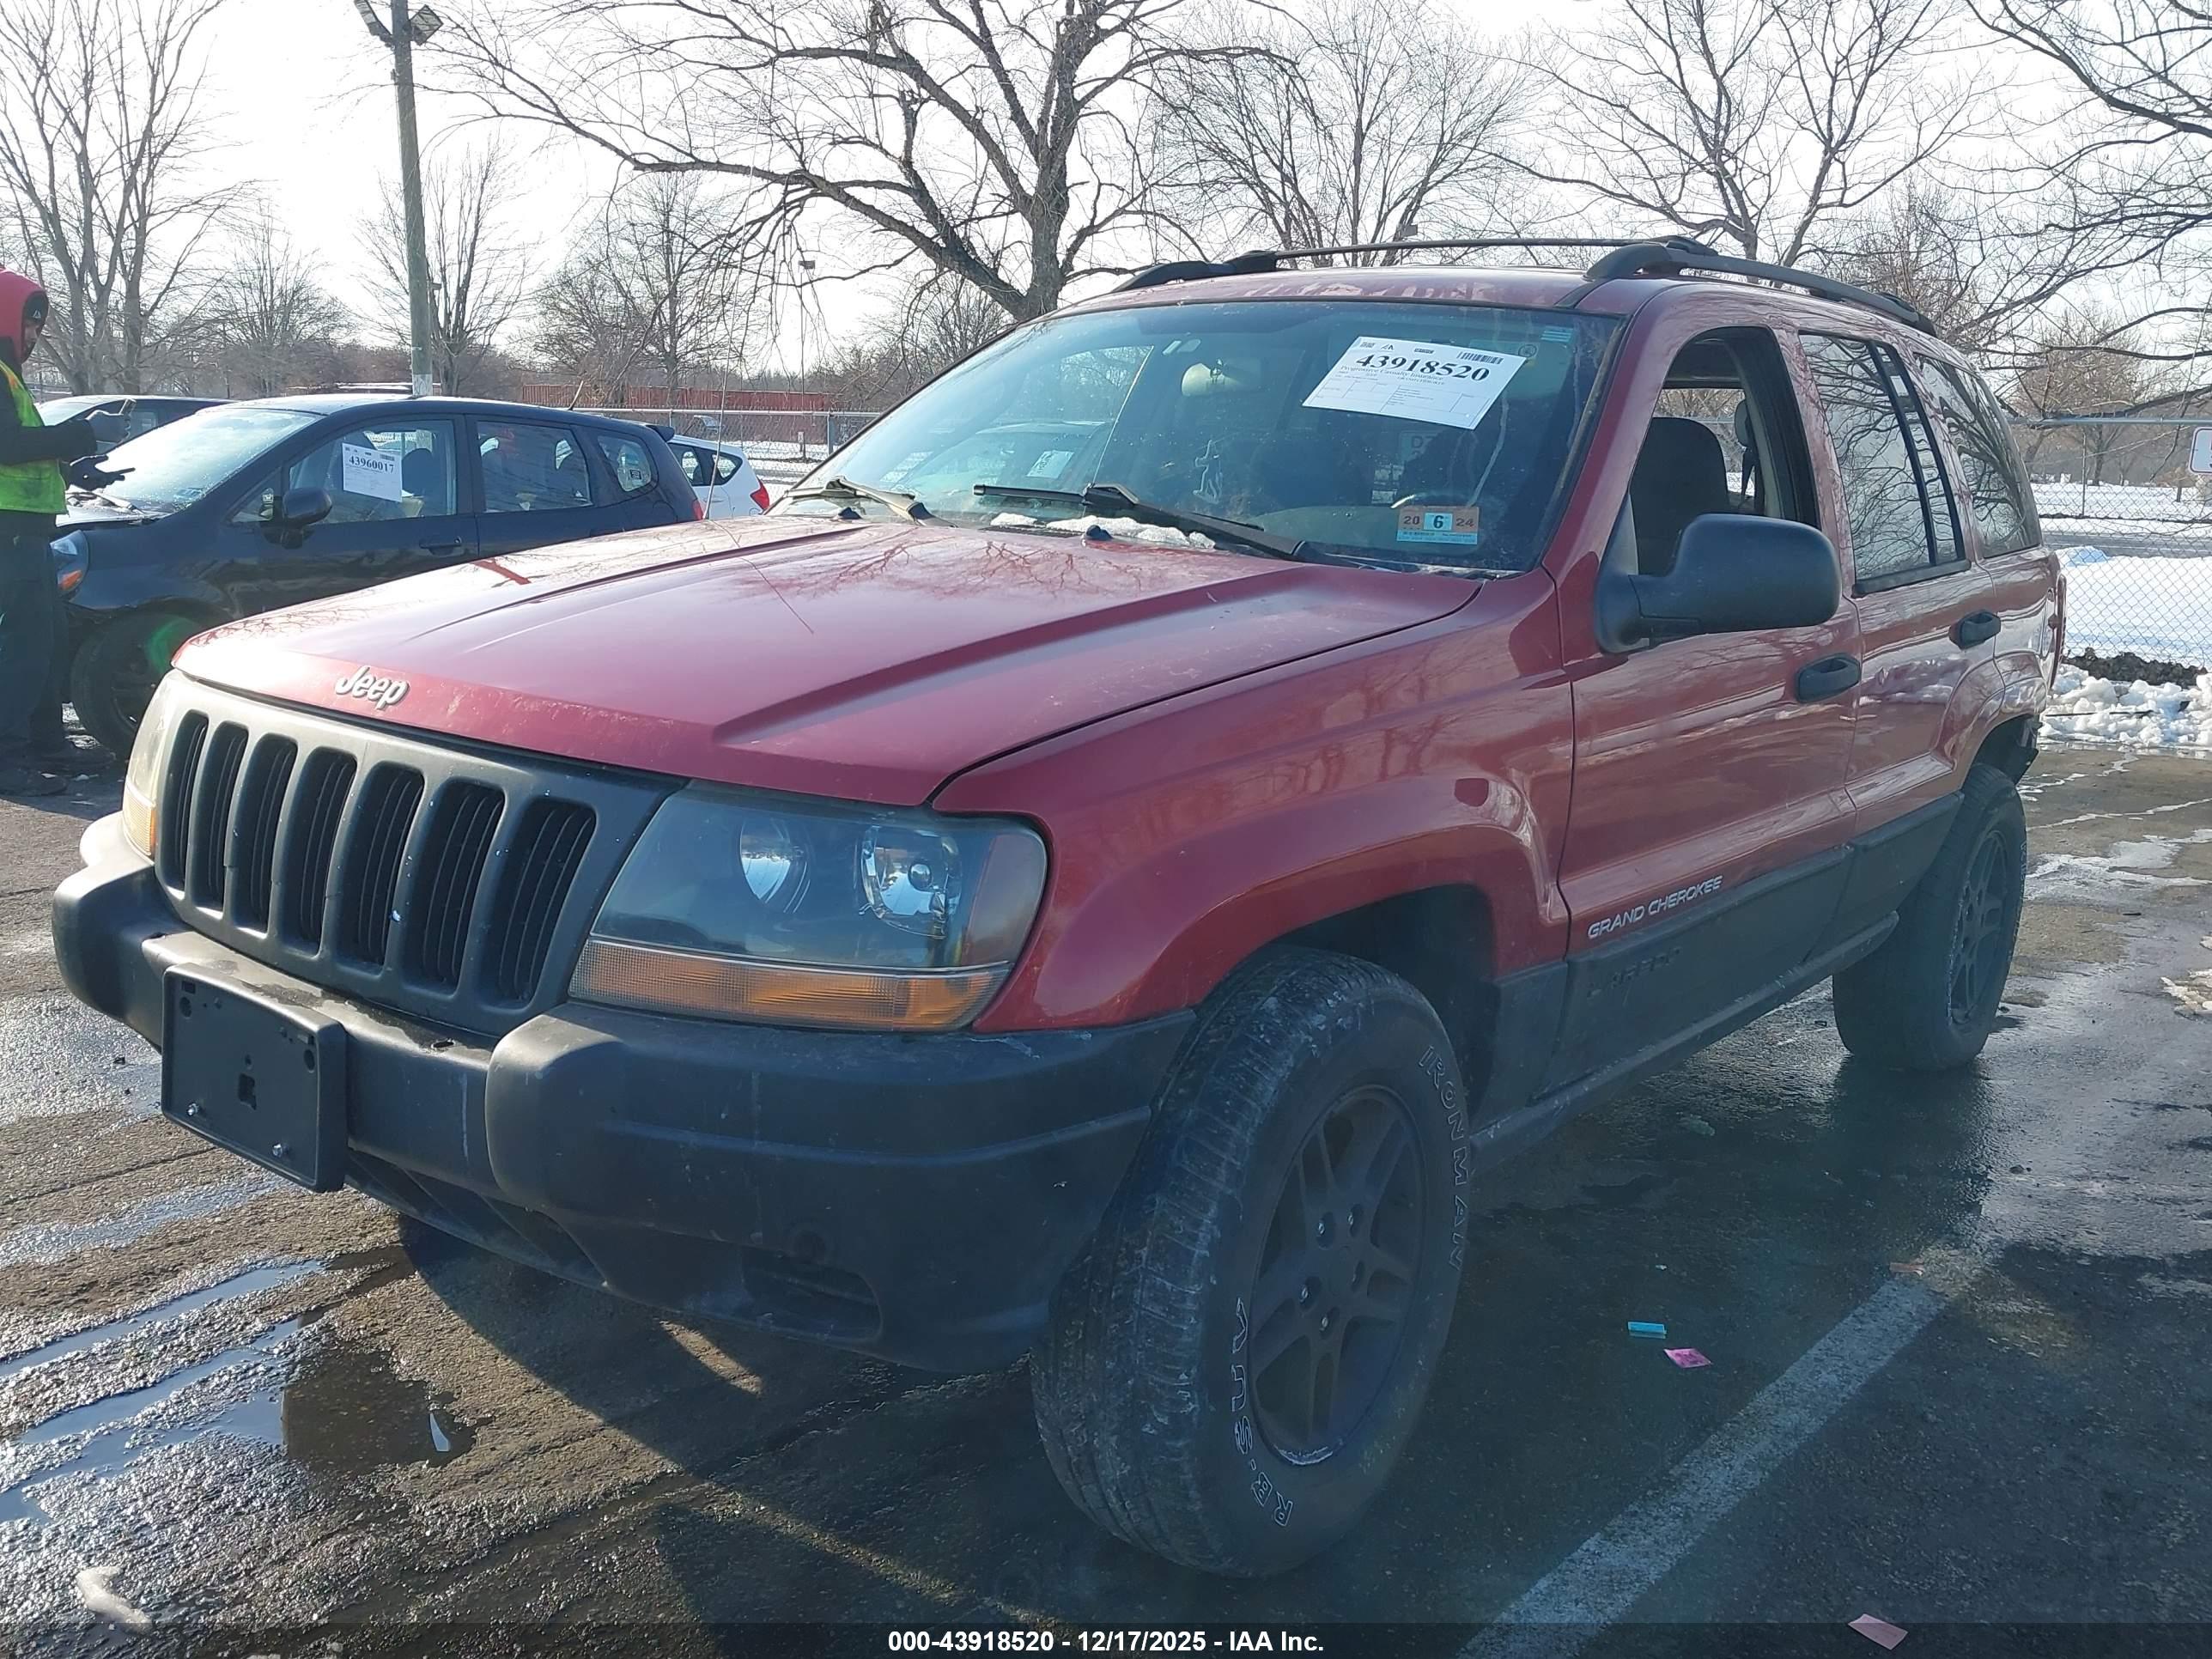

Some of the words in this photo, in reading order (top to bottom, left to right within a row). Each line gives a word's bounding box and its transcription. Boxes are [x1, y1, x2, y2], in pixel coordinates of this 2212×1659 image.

[1356, 354, 1490, 381] 43918520
[349, 455, 394, 473] 43960017
[1403, 515, 1420, 526] 20
[1433, 515, 1444, 529] 6
[1455, 518, 1474, 527] 24
[335, 665, 410, 711] Jeep
[1588, 906, 1645, 939] GRAND
[1648, 875, 1723, 915] CHEROKEE
